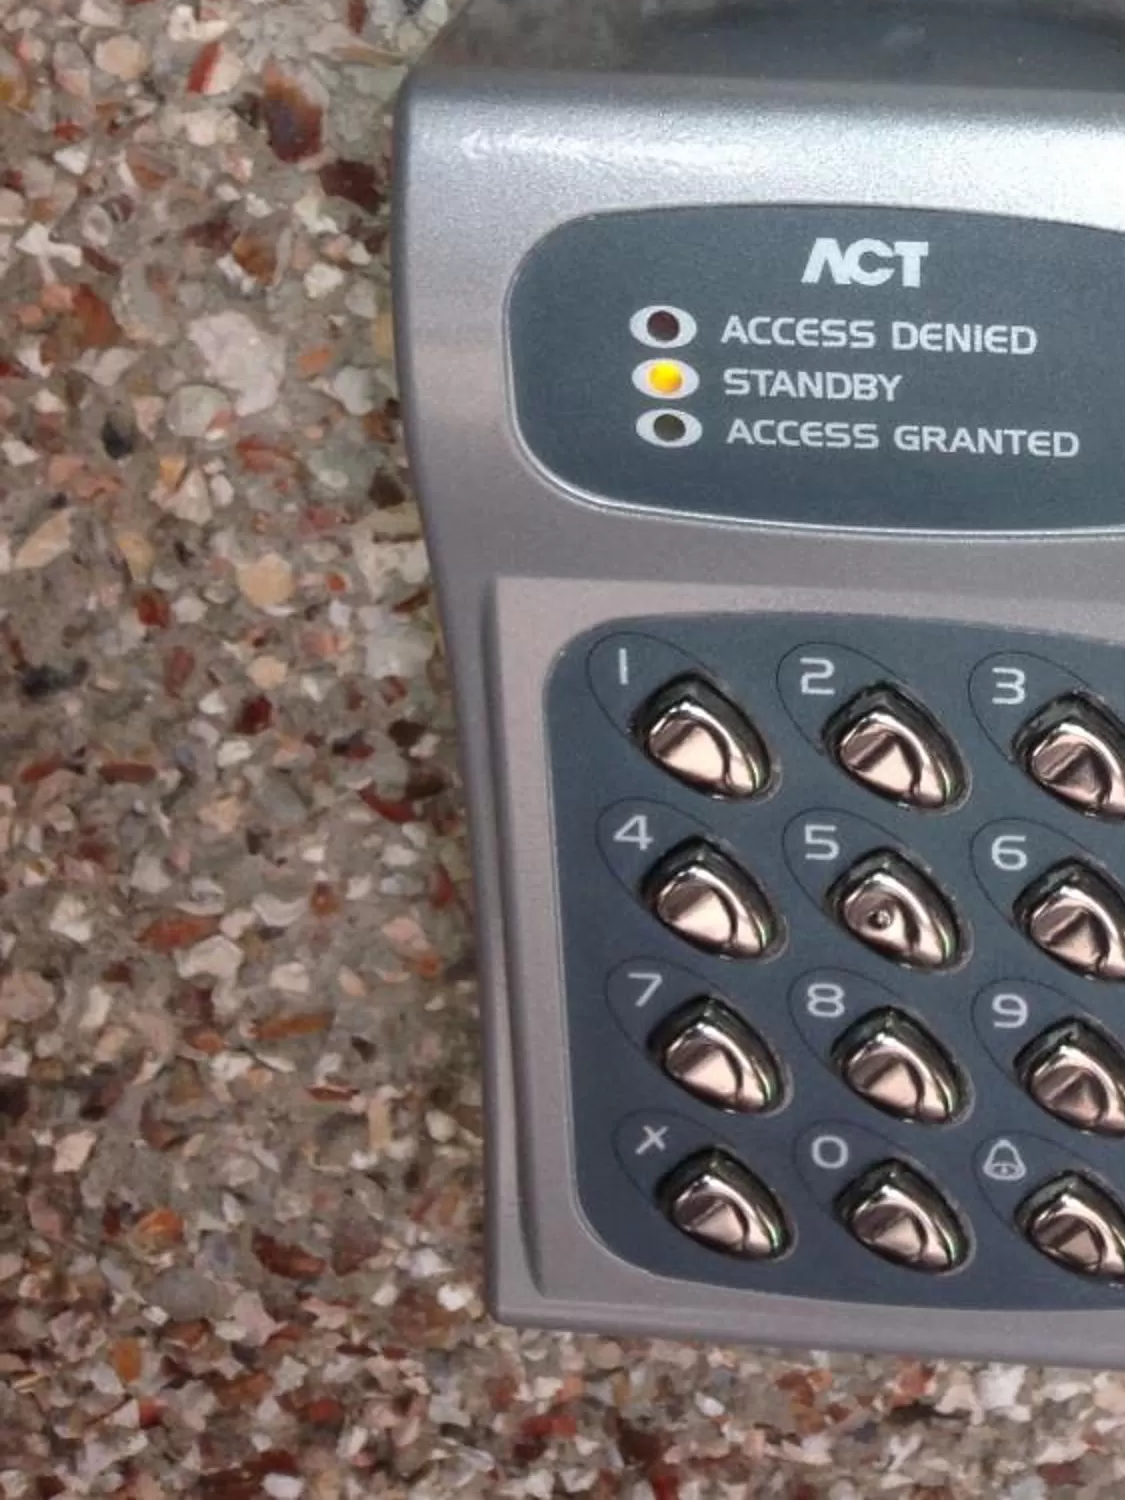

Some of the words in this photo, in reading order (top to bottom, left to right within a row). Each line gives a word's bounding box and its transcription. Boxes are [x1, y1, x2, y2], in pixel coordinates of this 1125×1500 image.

[801, 236, 929, 288] ACT
[720, 314, 877, 350] ACCESS
[891, 321, 1038, 356] DENIED
[722, 367, 904, 401] STANDBY
[726, 418, 880, 451] ACCESS
[893, 424, 1080, 459] GRANTED
[798, 657, 836, 696] 2
[990, 666, 1027, 705] 3
[612, 814, 655, 851] 4
[803, 823, 840, 861] 5
[990, 834, 1028, 871] 6
[626, 972, 663, 1007] 7
[806, 982, 845, 1018] 8
[990, 993, 1028, 1029] 9
